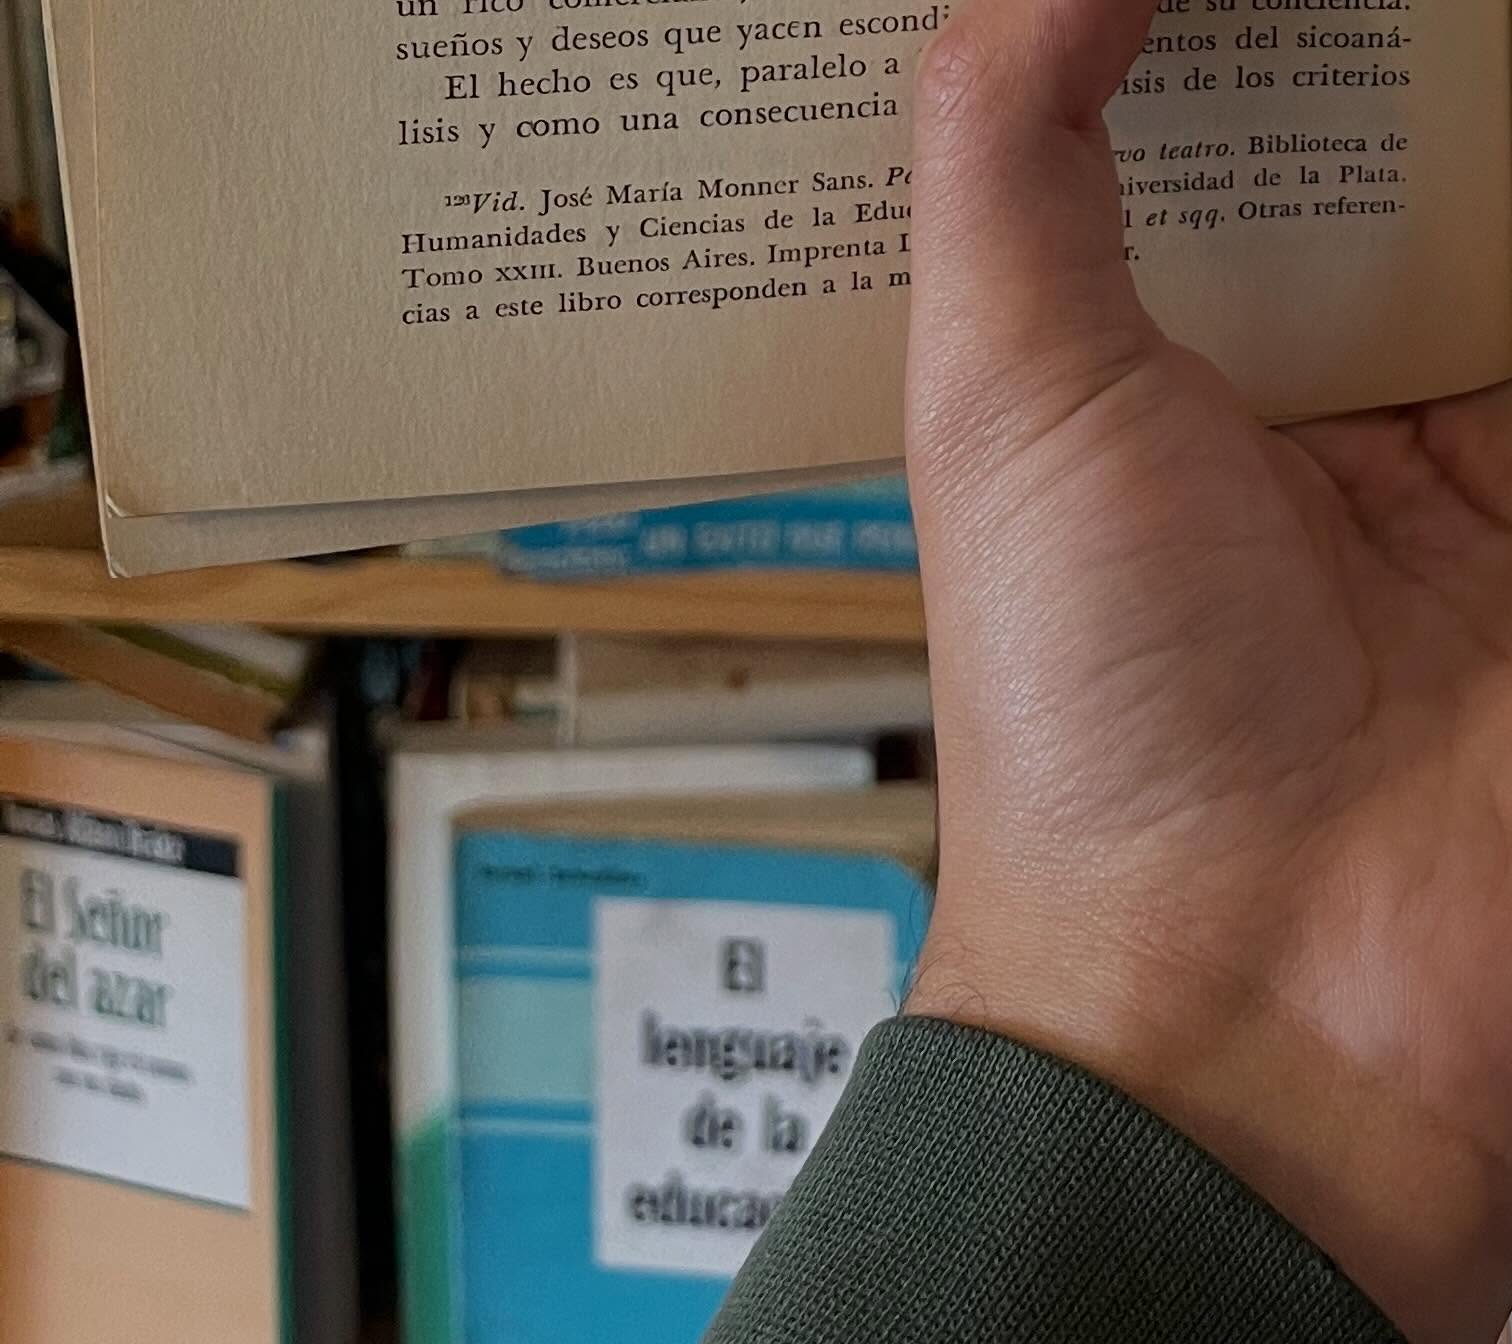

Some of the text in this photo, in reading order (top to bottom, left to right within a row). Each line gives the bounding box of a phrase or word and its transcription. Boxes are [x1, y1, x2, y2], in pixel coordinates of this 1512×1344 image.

[537, 132, 1408, 217] José María Monner Sans. teatro. Biblioteca de
[401, 270, 873, 325] cias a este libro corresponden a la
[641, 1009, 849, 1089] lenguaje
[684, 1089, 808, 1153] de la
